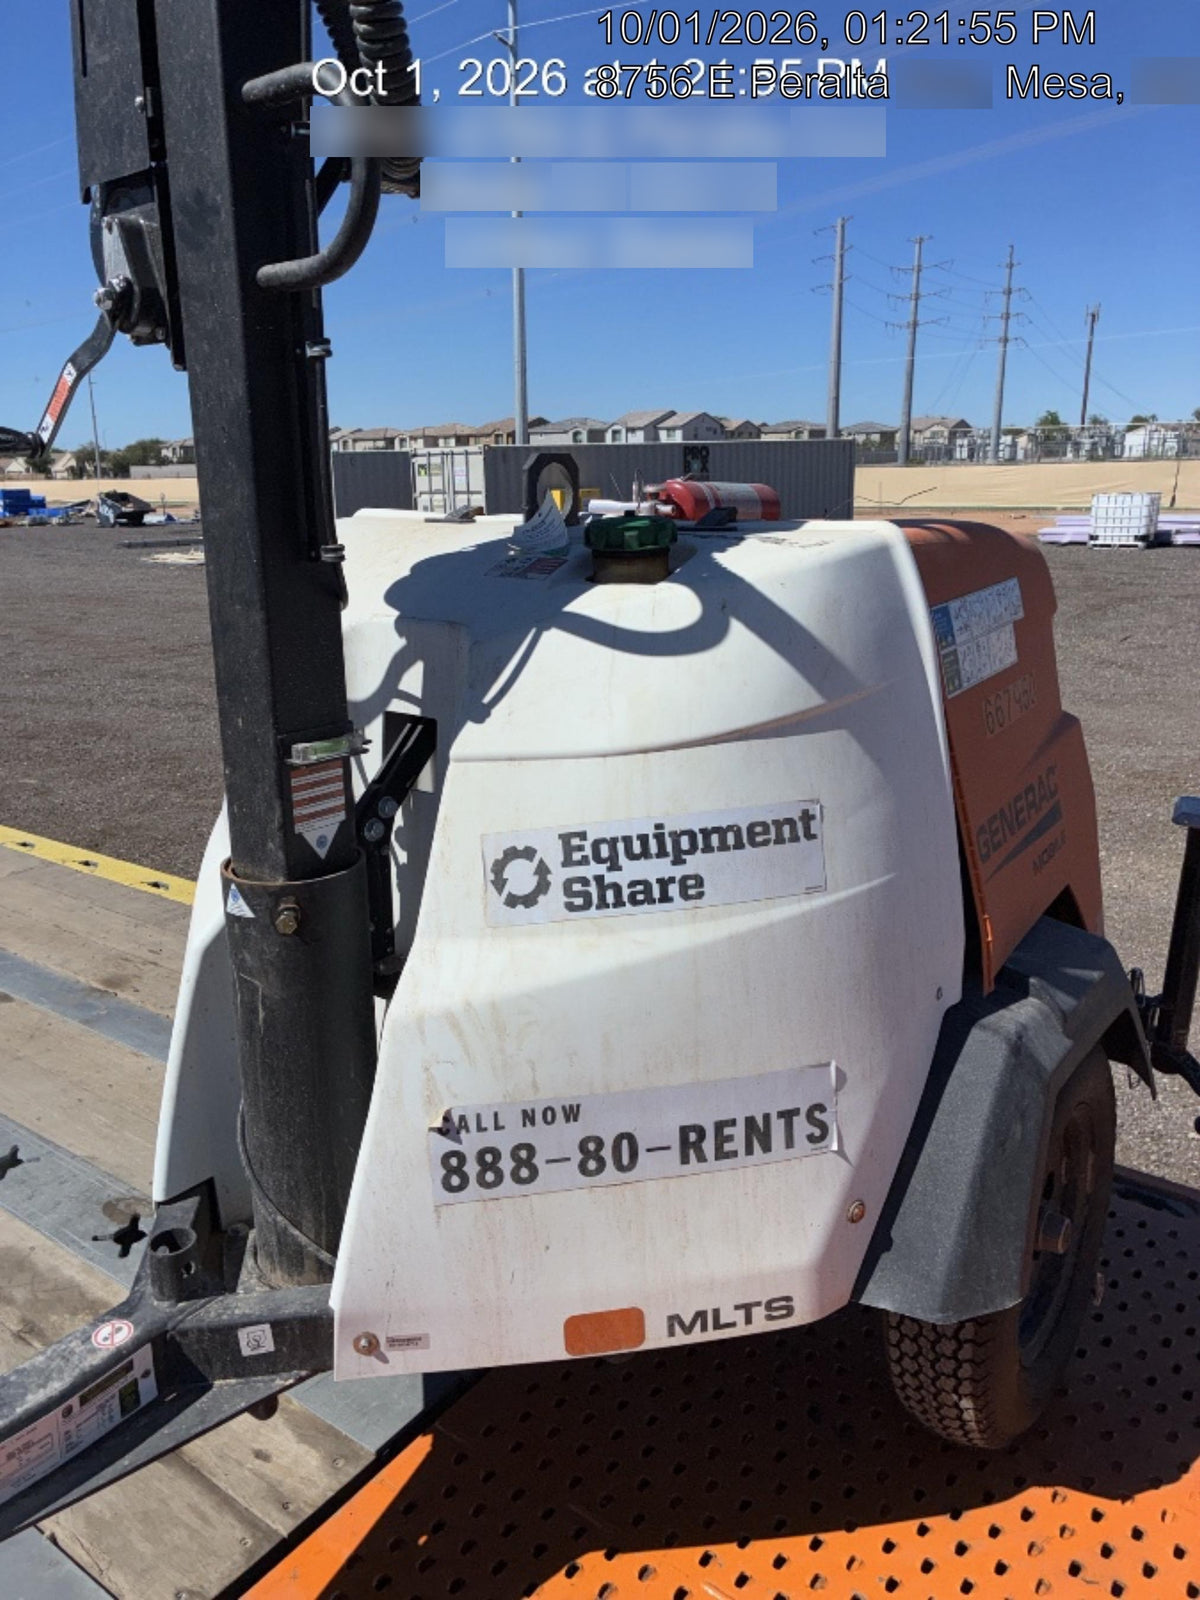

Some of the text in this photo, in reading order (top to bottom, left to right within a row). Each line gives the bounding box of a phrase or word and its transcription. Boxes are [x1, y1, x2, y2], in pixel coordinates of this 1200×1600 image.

[558, 808, 818, 872] Equipment
[976, 764, 1059, 864] GENERAC
[561, 873, 706, 913] Share
[521, 1103, 582, 1128] NOW
[440, 1102, 830, 1194] 888-80-RENTS
[666, 1296, 796, 1338] MLTS
